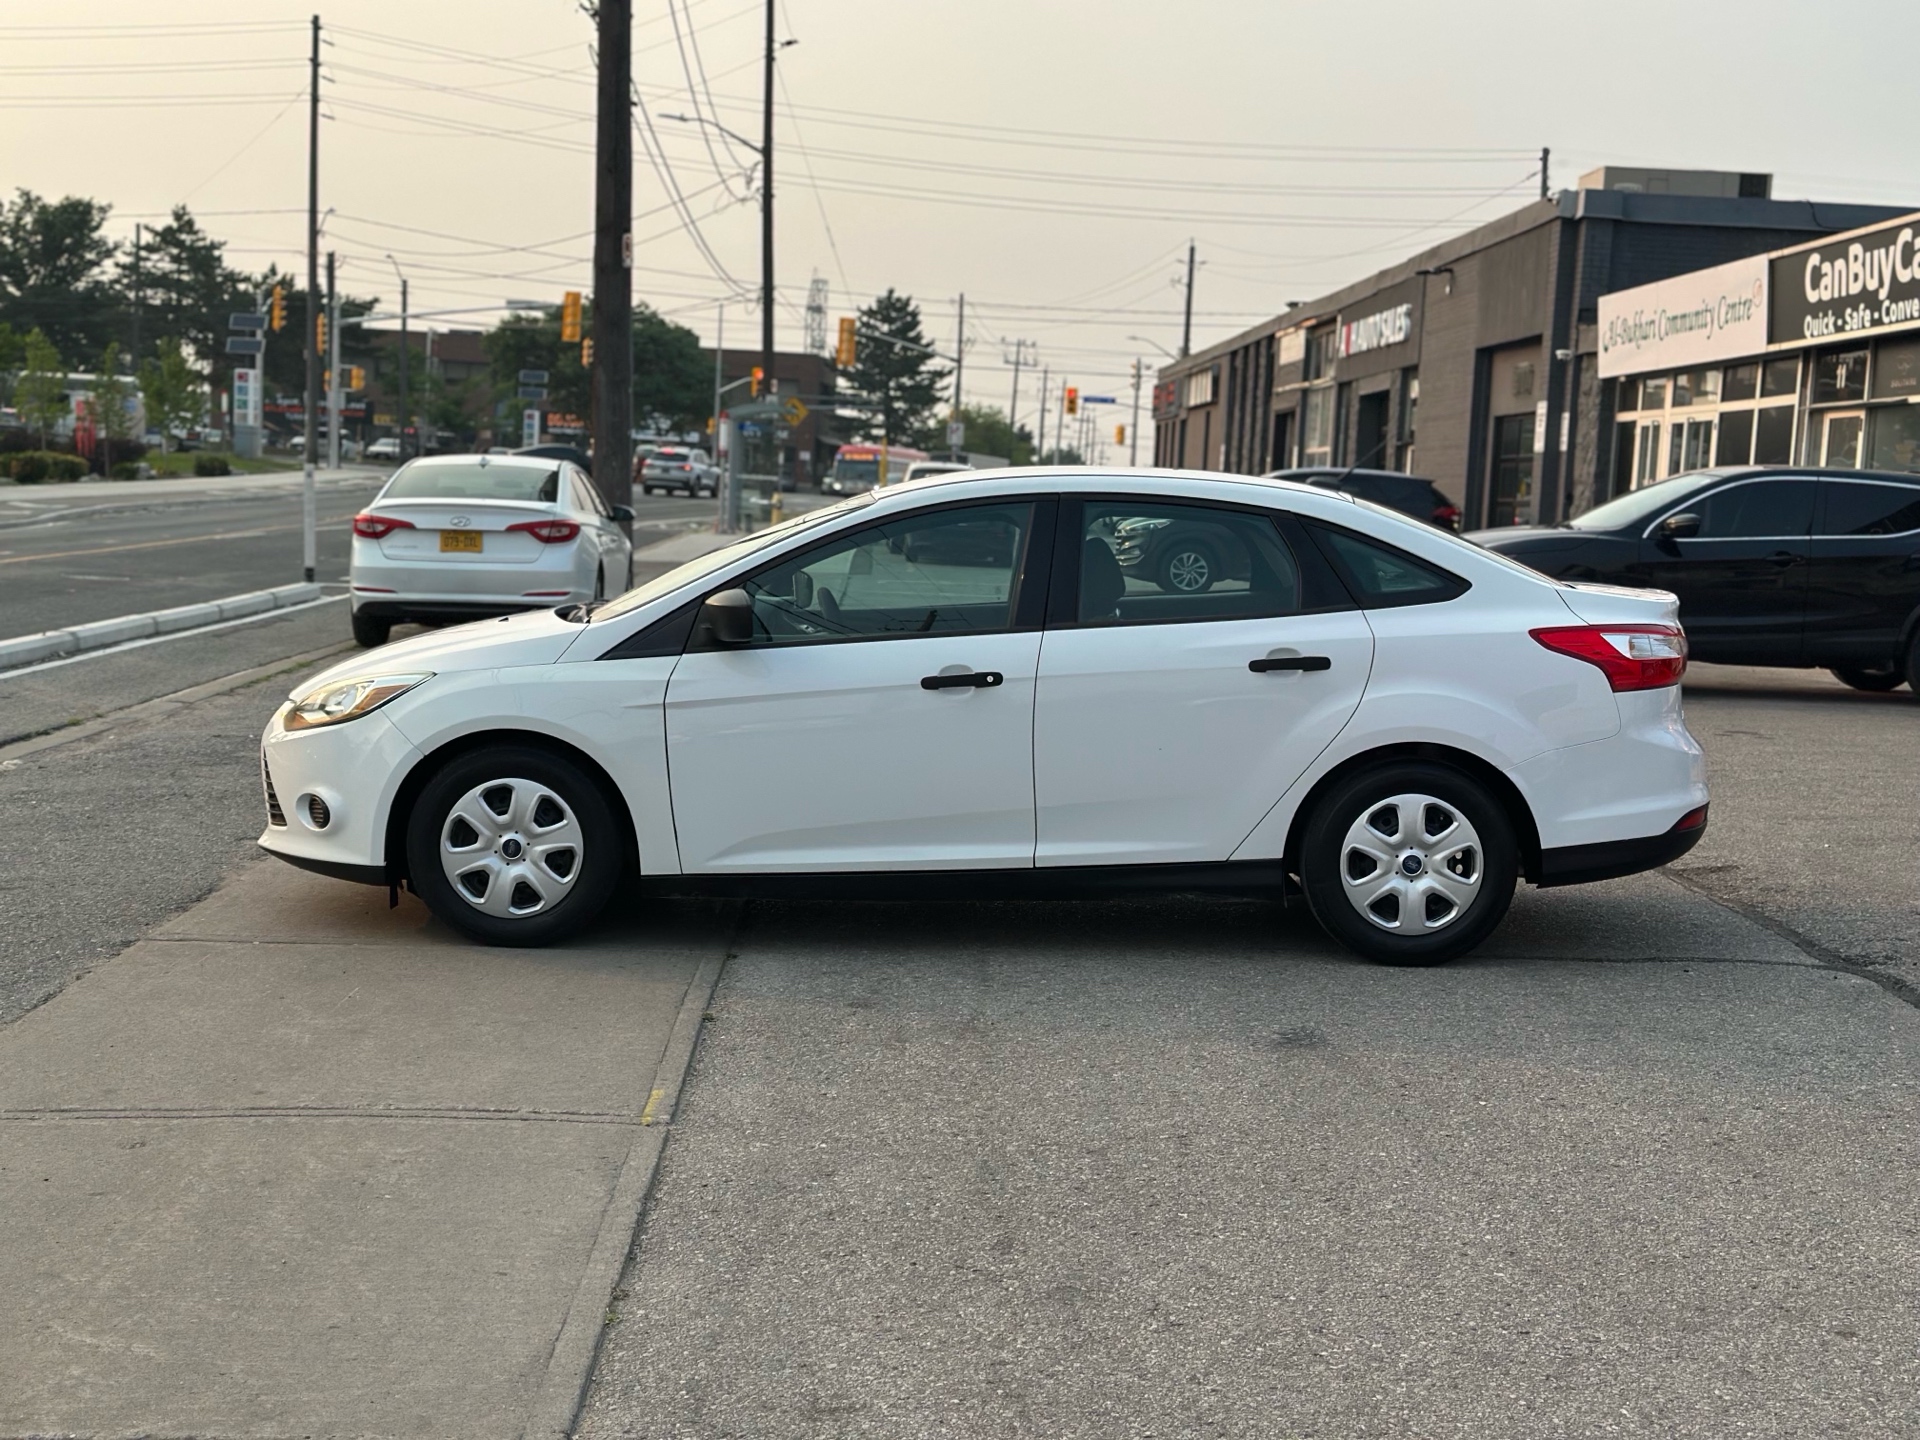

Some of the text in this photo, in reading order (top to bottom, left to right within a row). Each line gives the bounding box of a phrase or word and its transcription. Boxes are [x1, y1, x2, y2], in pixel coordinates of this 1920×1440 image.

[1657, 298, 1715, 341] Community
[1717, 295, 1753, 331] Centre
[1803, 309, 1836, 340] Quick
[1844, 303, 1872, 331] Safe
[1881, 297, 1920, 324] Conve
